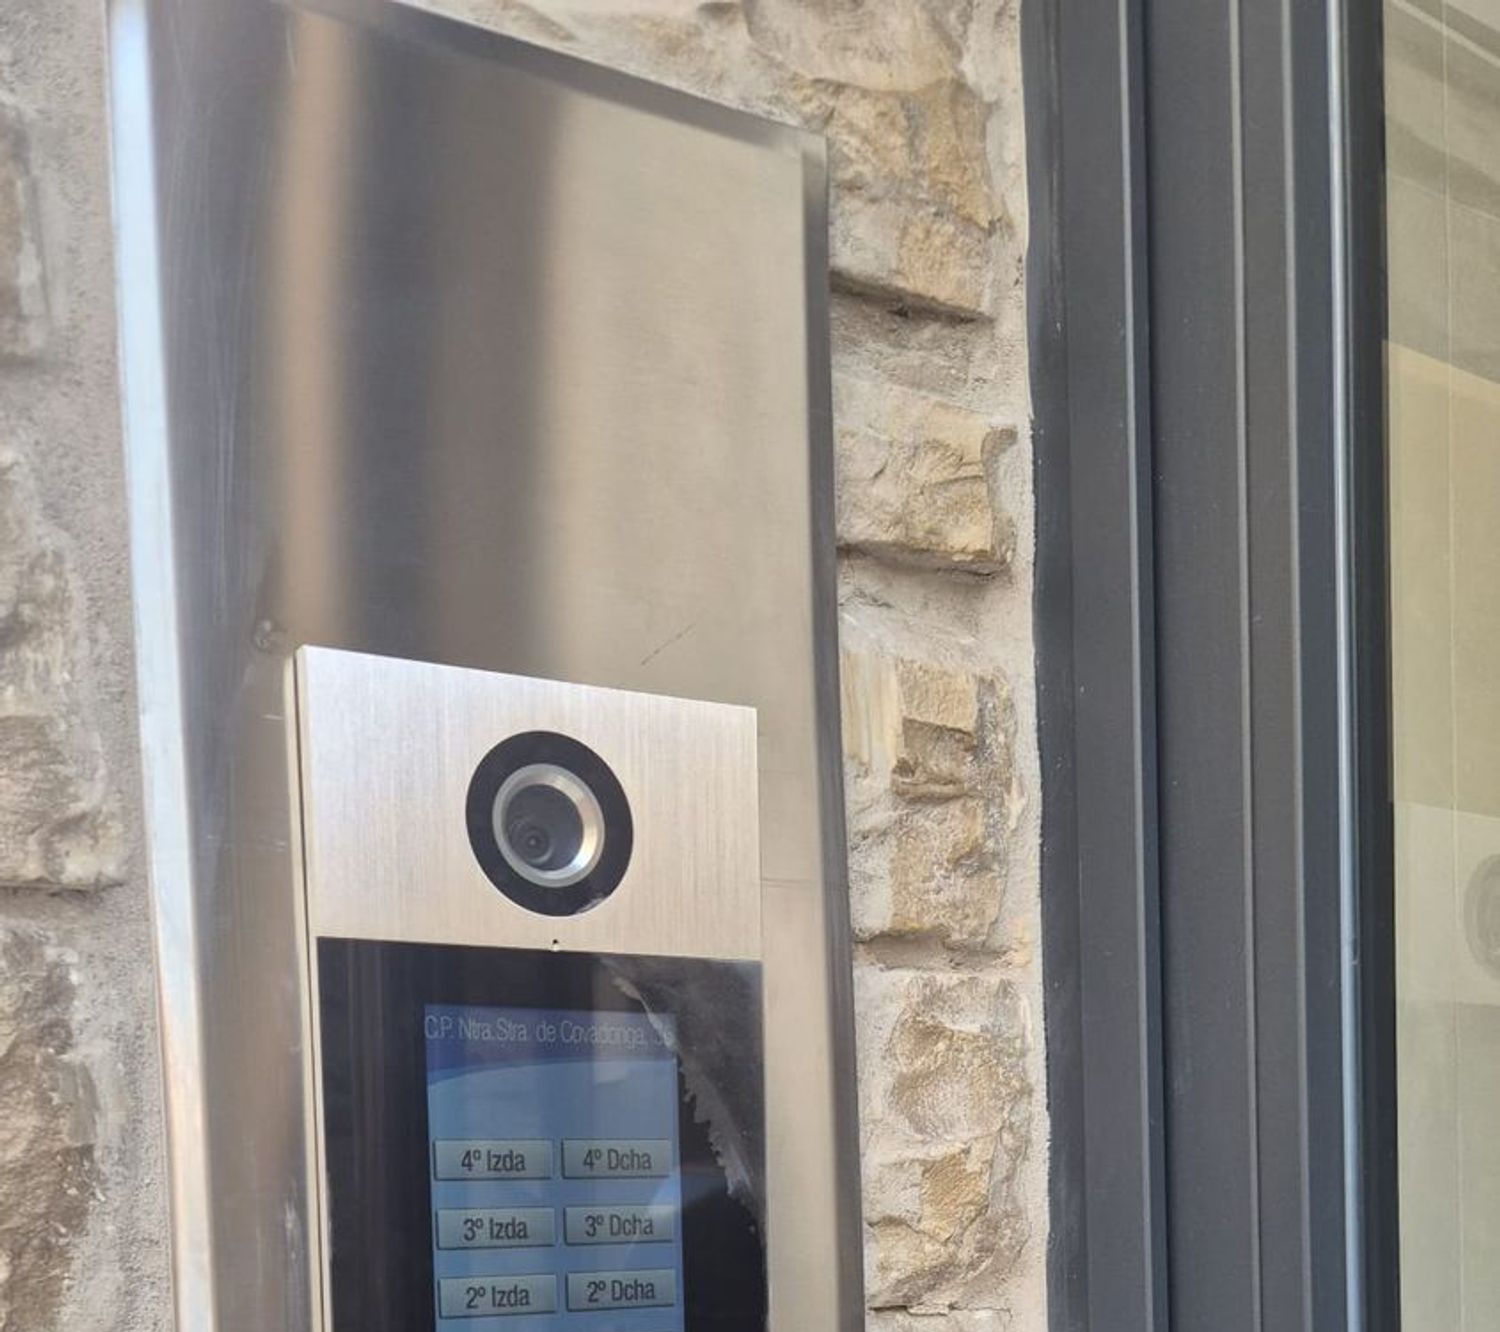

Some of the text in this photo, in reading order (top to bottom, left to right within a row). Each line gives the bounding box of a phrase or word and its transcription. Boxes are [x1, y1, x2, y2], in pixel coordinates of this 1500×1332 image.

[536, 1021, 557, 1043] de
[461, 1149, 526, 1172] 4º Izda
[583, 1148, 652, 1170] 4º Dcha
[463, 1217, 529, 1241] 3º Izda
[585, 1214, 654, 1237] 3º Dcha
[466, 1285, 530, 1309] 2º Izda
[588, 1279, 656, 1303] 2º Dcha
